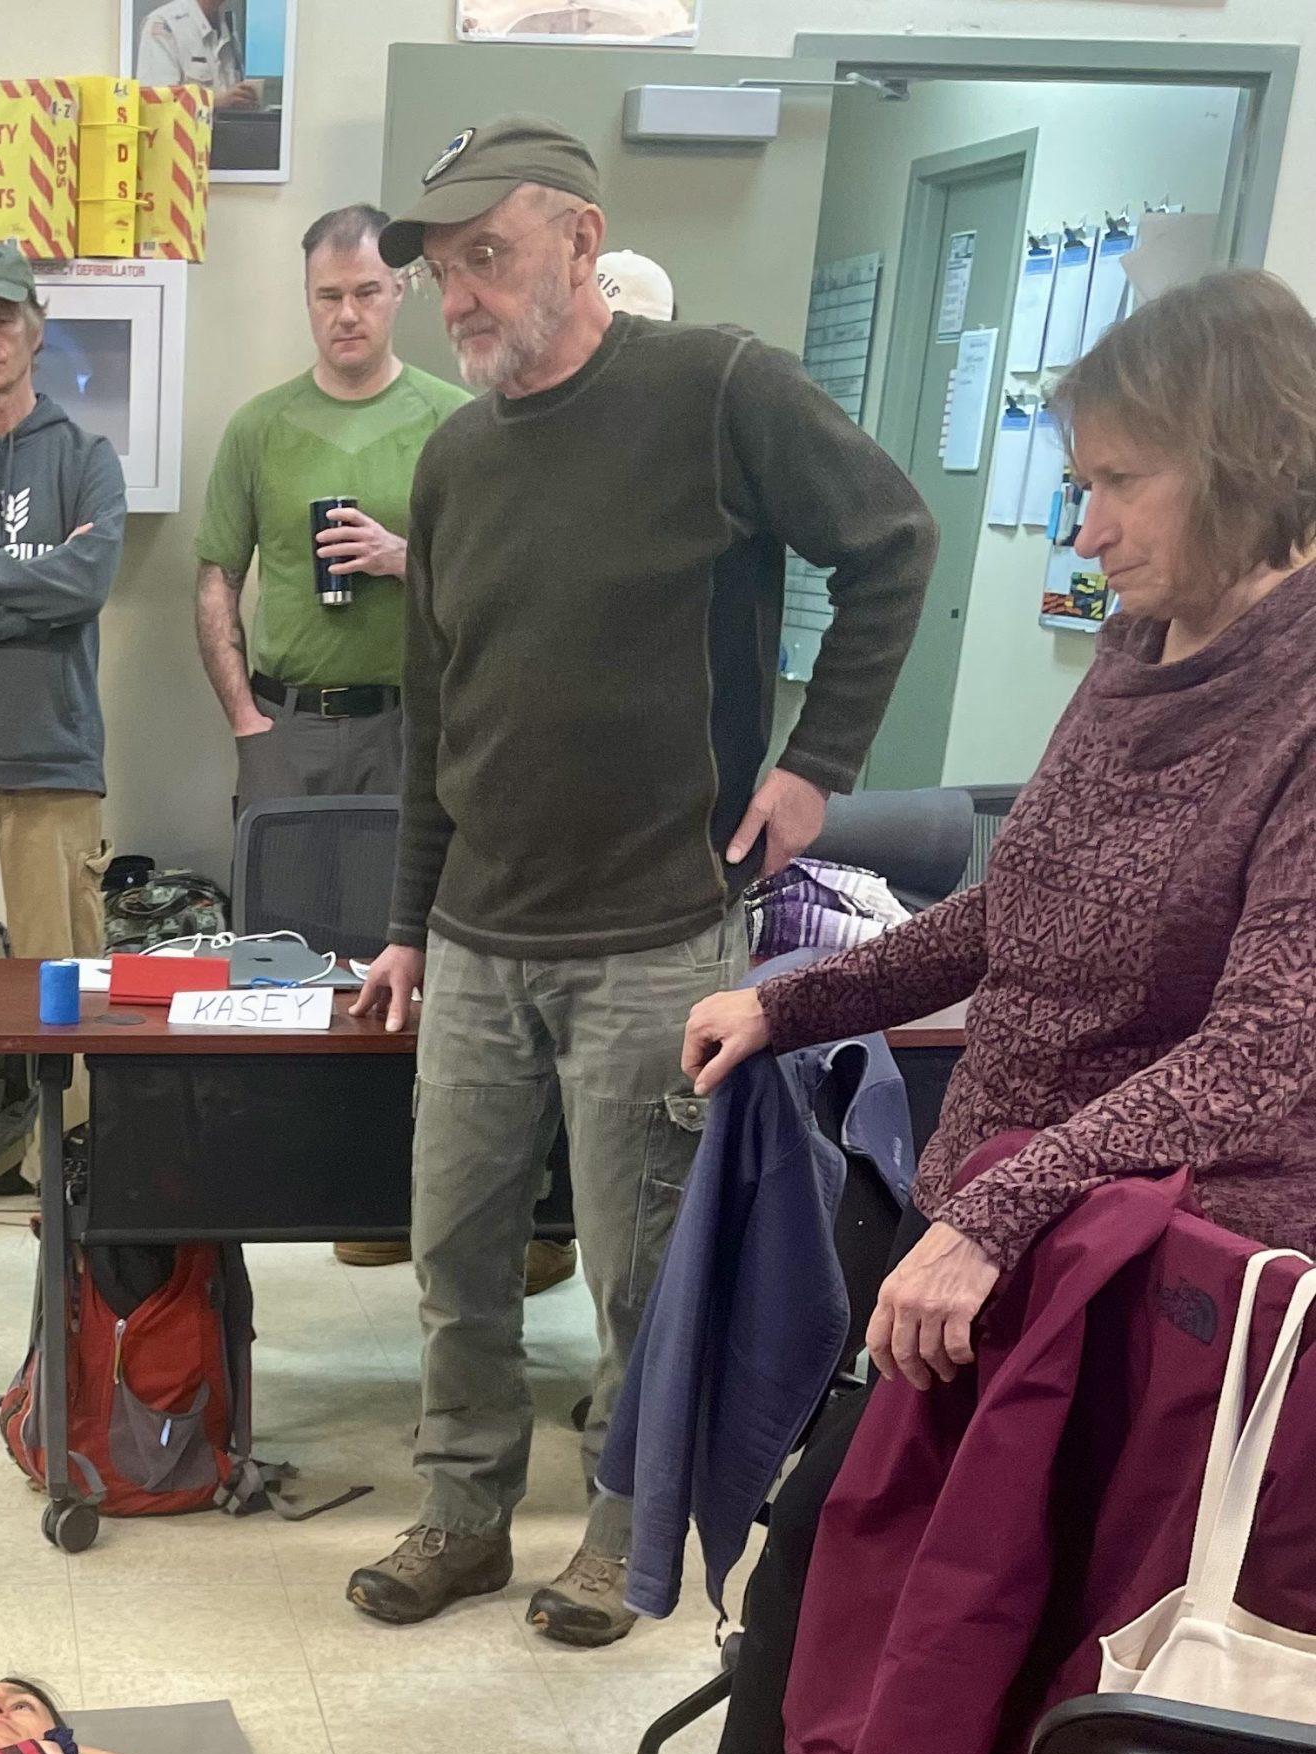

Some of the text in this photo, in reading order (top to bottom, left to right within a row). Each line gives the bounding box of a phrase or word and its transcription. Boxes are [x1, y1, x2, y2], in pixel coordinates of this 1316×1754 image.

[56, 145, 67, 189] SDS
[75, 264, 146, 277] DEFIBRILLATOR
[192, 993, 315, 1022] KASEY
